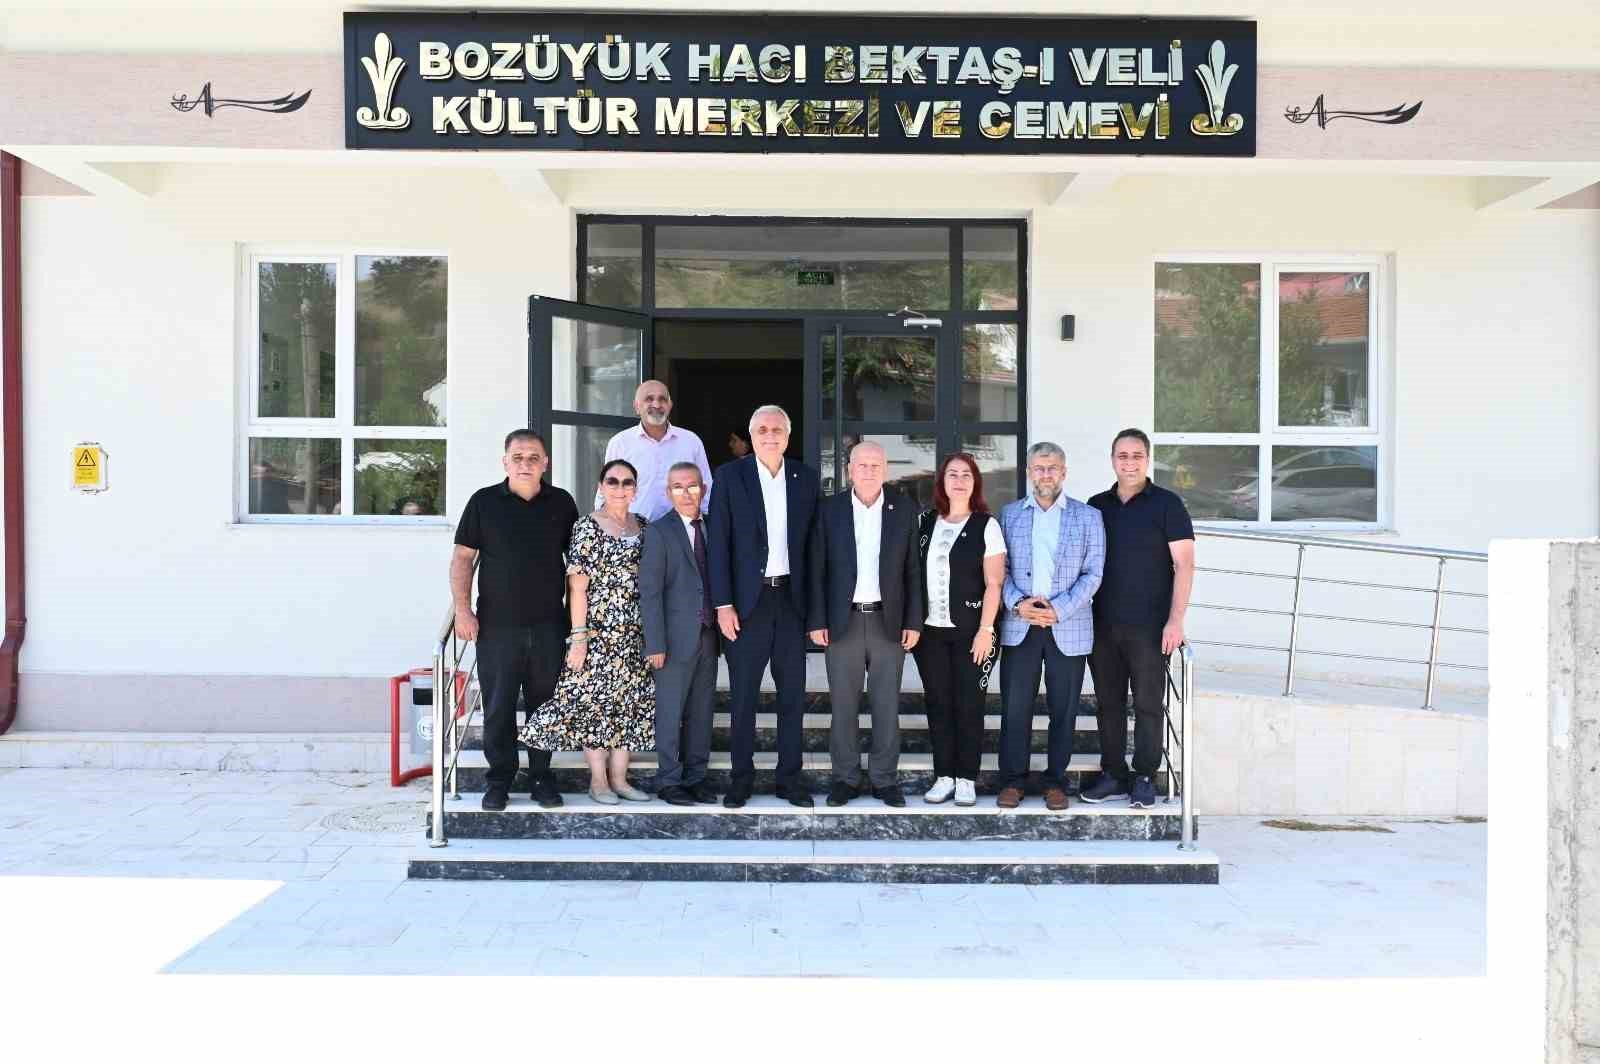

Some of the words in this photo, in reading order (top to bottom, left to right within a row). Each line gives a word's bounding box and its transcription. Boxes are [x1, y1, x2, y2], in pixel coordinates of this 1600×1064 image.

[418, 34, 673, 81] BOZÜYÜK
[688, 43, 806, 83] HACI
[823, 44, 1055, 94] BEKTAŞ-I
[1069, 39, 1184, 86] VELİ
[431, 88, 639, 136] KÜLTÜR
[894, 100, 962, 138] VE
[978, 93, 1171, 140] CEMEVİ
